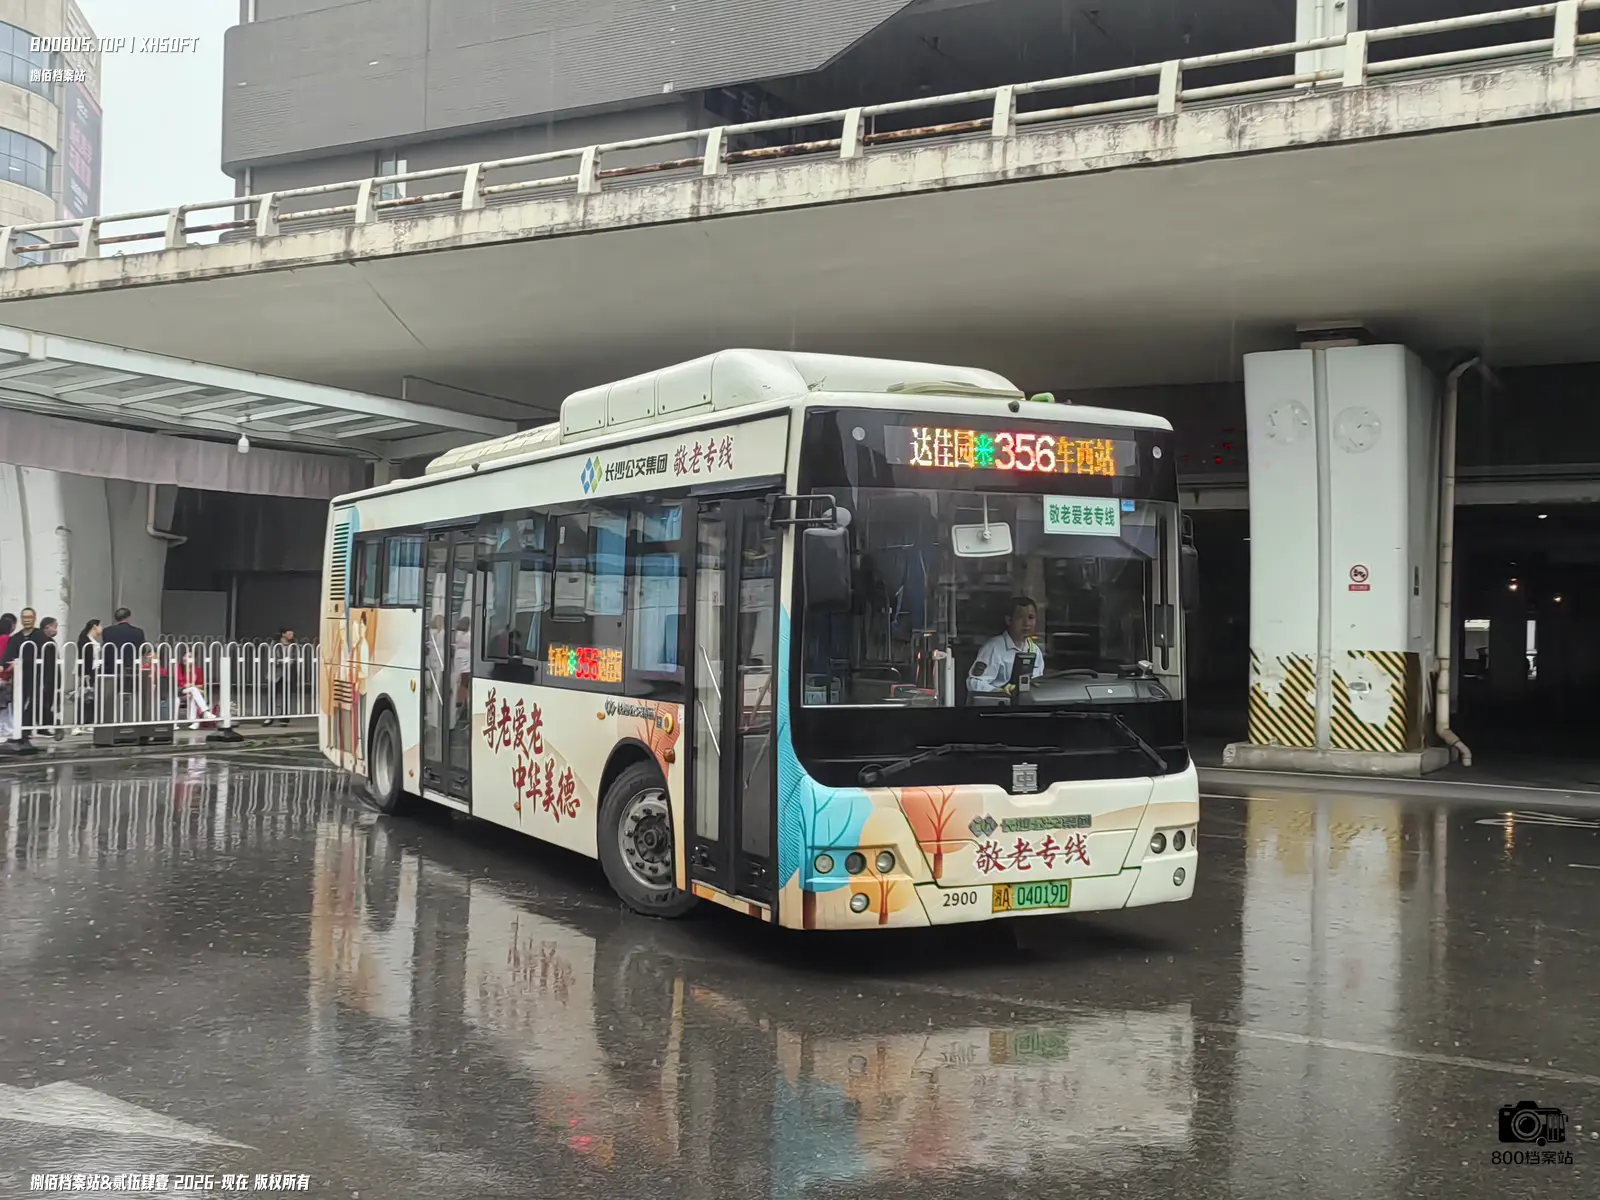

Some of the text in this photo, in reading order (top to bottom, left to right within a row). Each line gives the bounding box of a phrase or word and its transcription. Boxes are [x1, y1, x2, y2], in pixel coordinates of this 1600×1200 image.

[605, 435, 734, 482] 长沙公交集团 敬老专线
[993, 432, 1057, 473] 356
[1055, 437, 1116, 477] 车西站
[1049, 504, 1115, 527] 敬老爱老专线
[482, 687, 545, 759] 尊老爱老
[511, 755, 581, 826] 中华美德
[975, 832, 1091, 875] 敬老专线
[943, 891, 977, 907] 2900
[1017, 884, 1068, 905] 04019D
